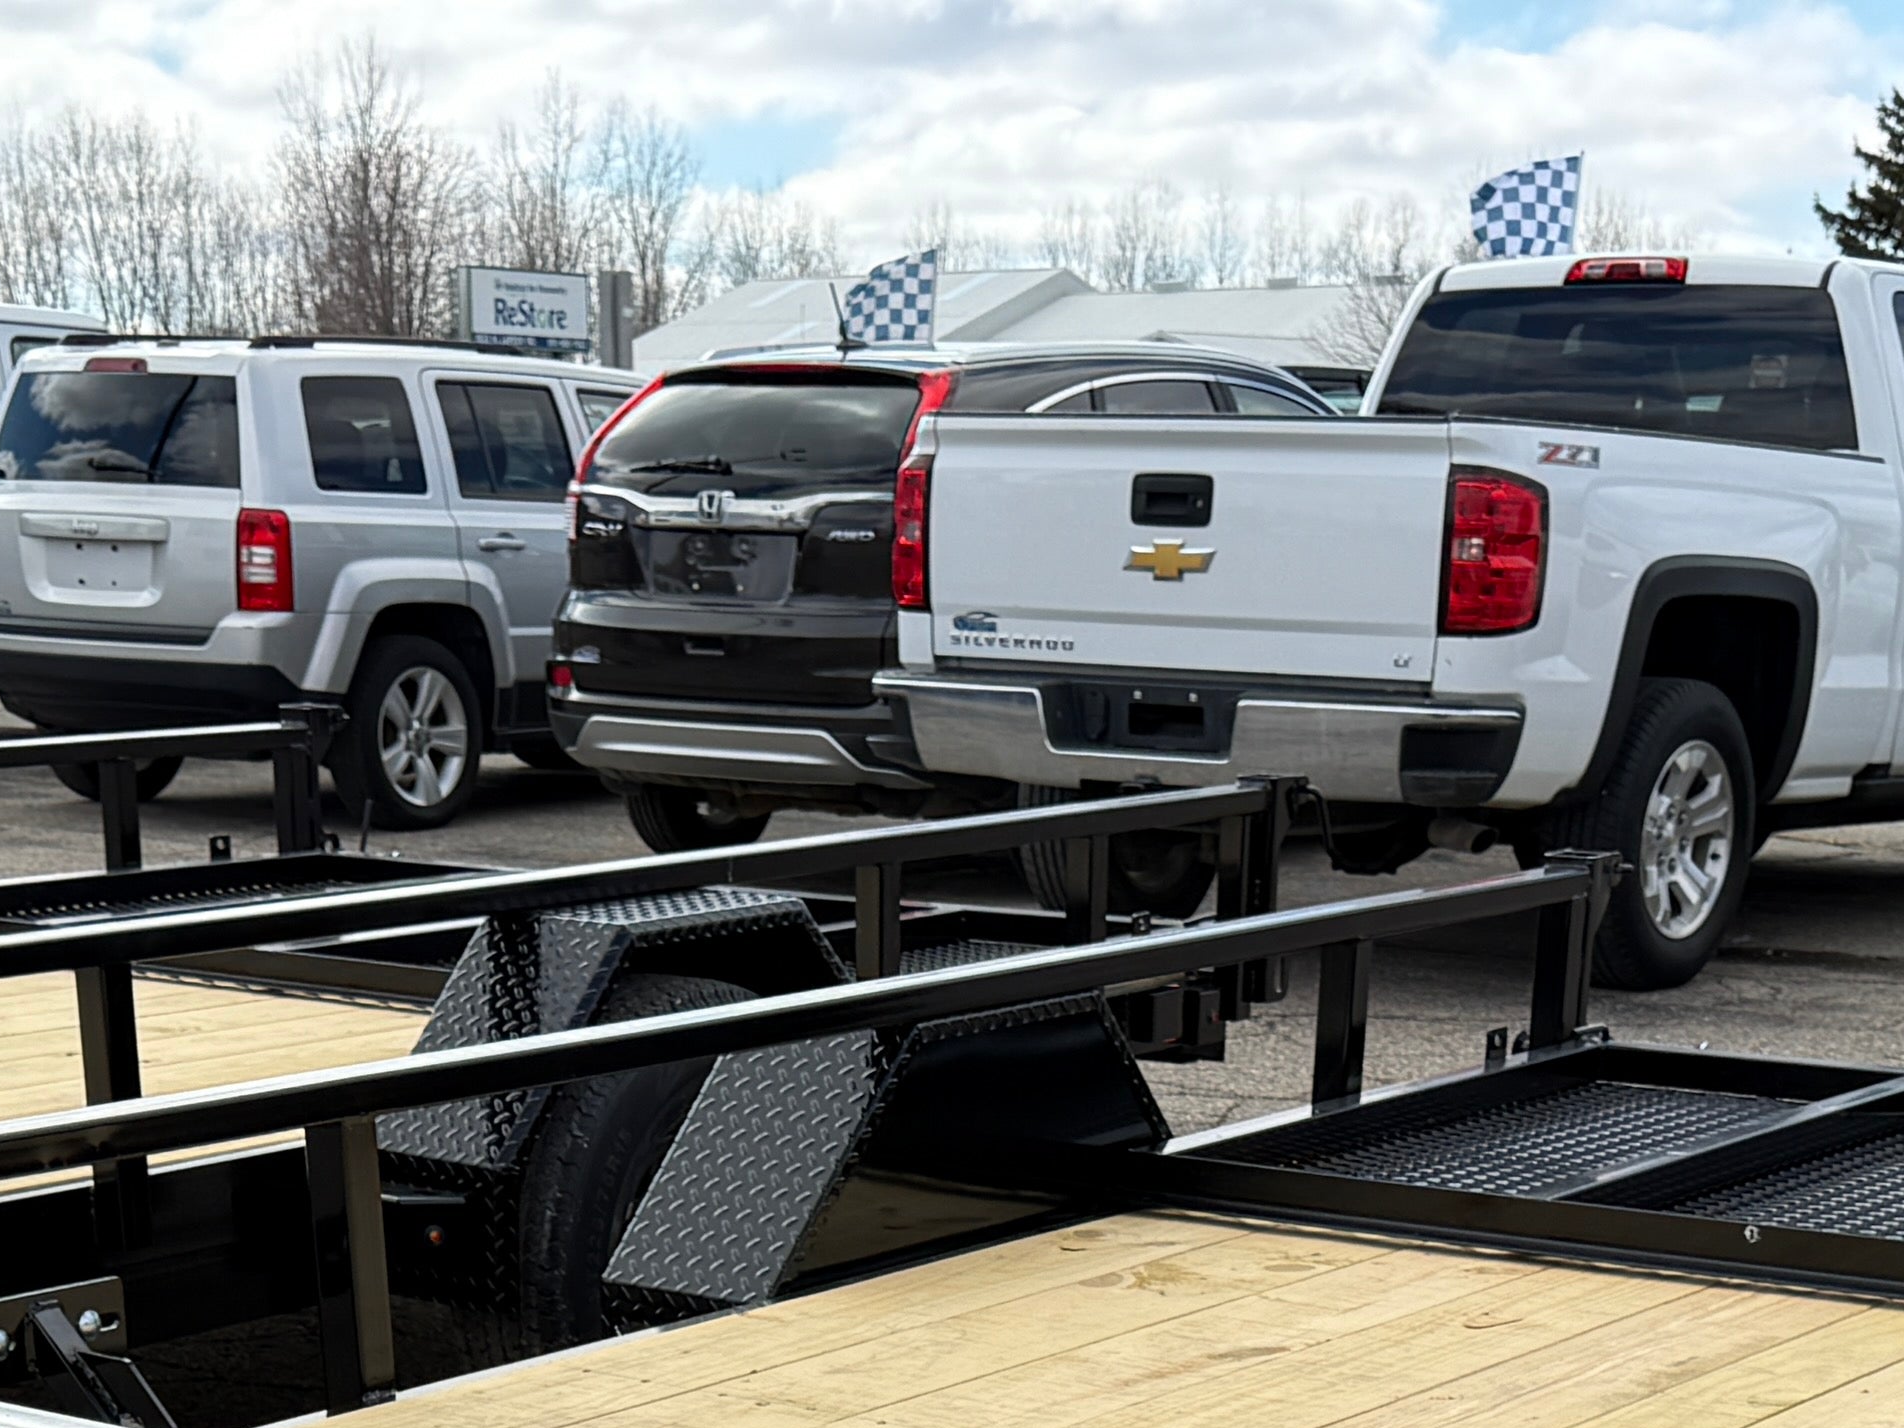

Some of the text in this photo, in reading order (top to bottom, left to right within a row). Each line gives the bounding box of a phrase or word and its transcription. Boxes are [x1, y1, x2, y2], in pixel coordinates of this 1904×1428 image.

[494, 298, 568, 330] ReStore
[1537, 441, 1600, 470] Z71
[950, 635, 1075, 651] SILVERADO
